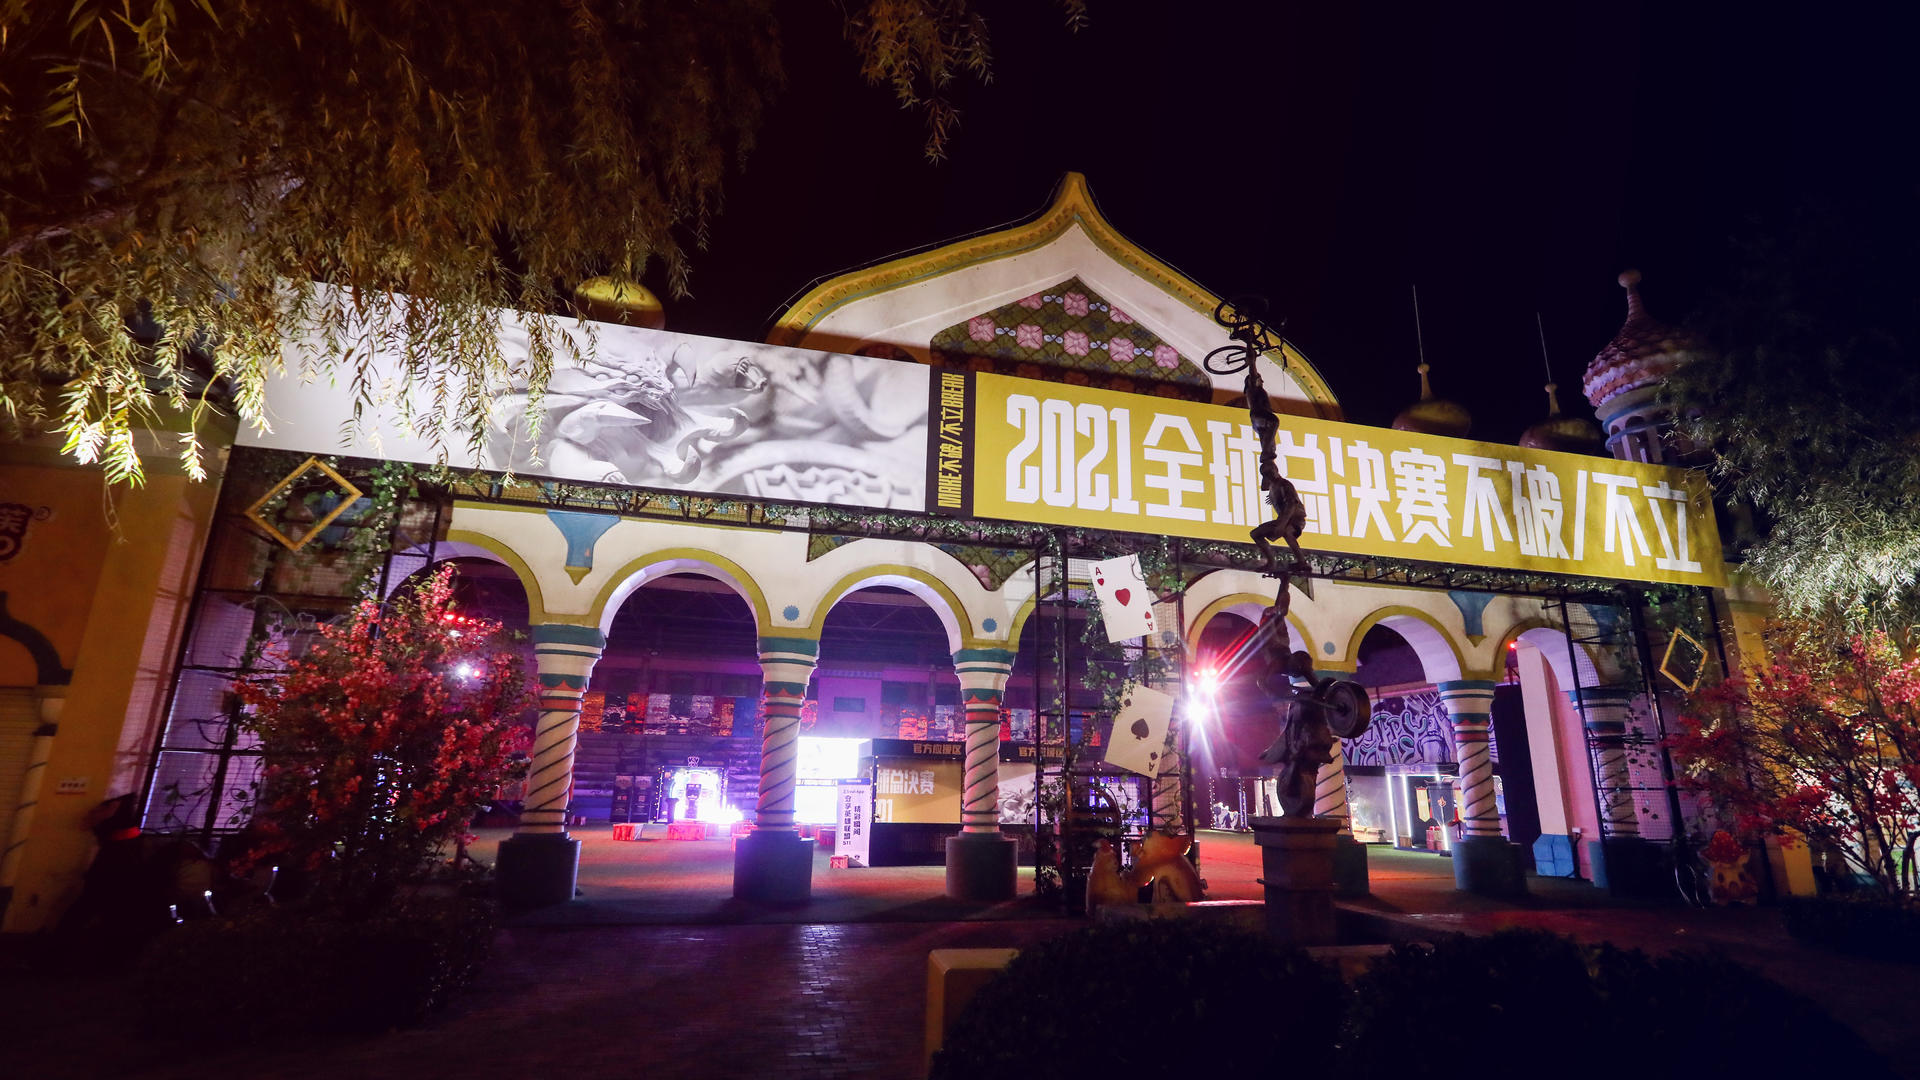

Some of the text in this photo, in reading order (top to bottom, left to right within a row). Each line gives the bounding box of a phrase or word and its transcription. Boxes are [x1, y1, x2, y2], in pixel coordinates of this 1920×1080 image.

[1095, 566, 1102, 576] A
[913, 743, 962, 755] 官方应援区
